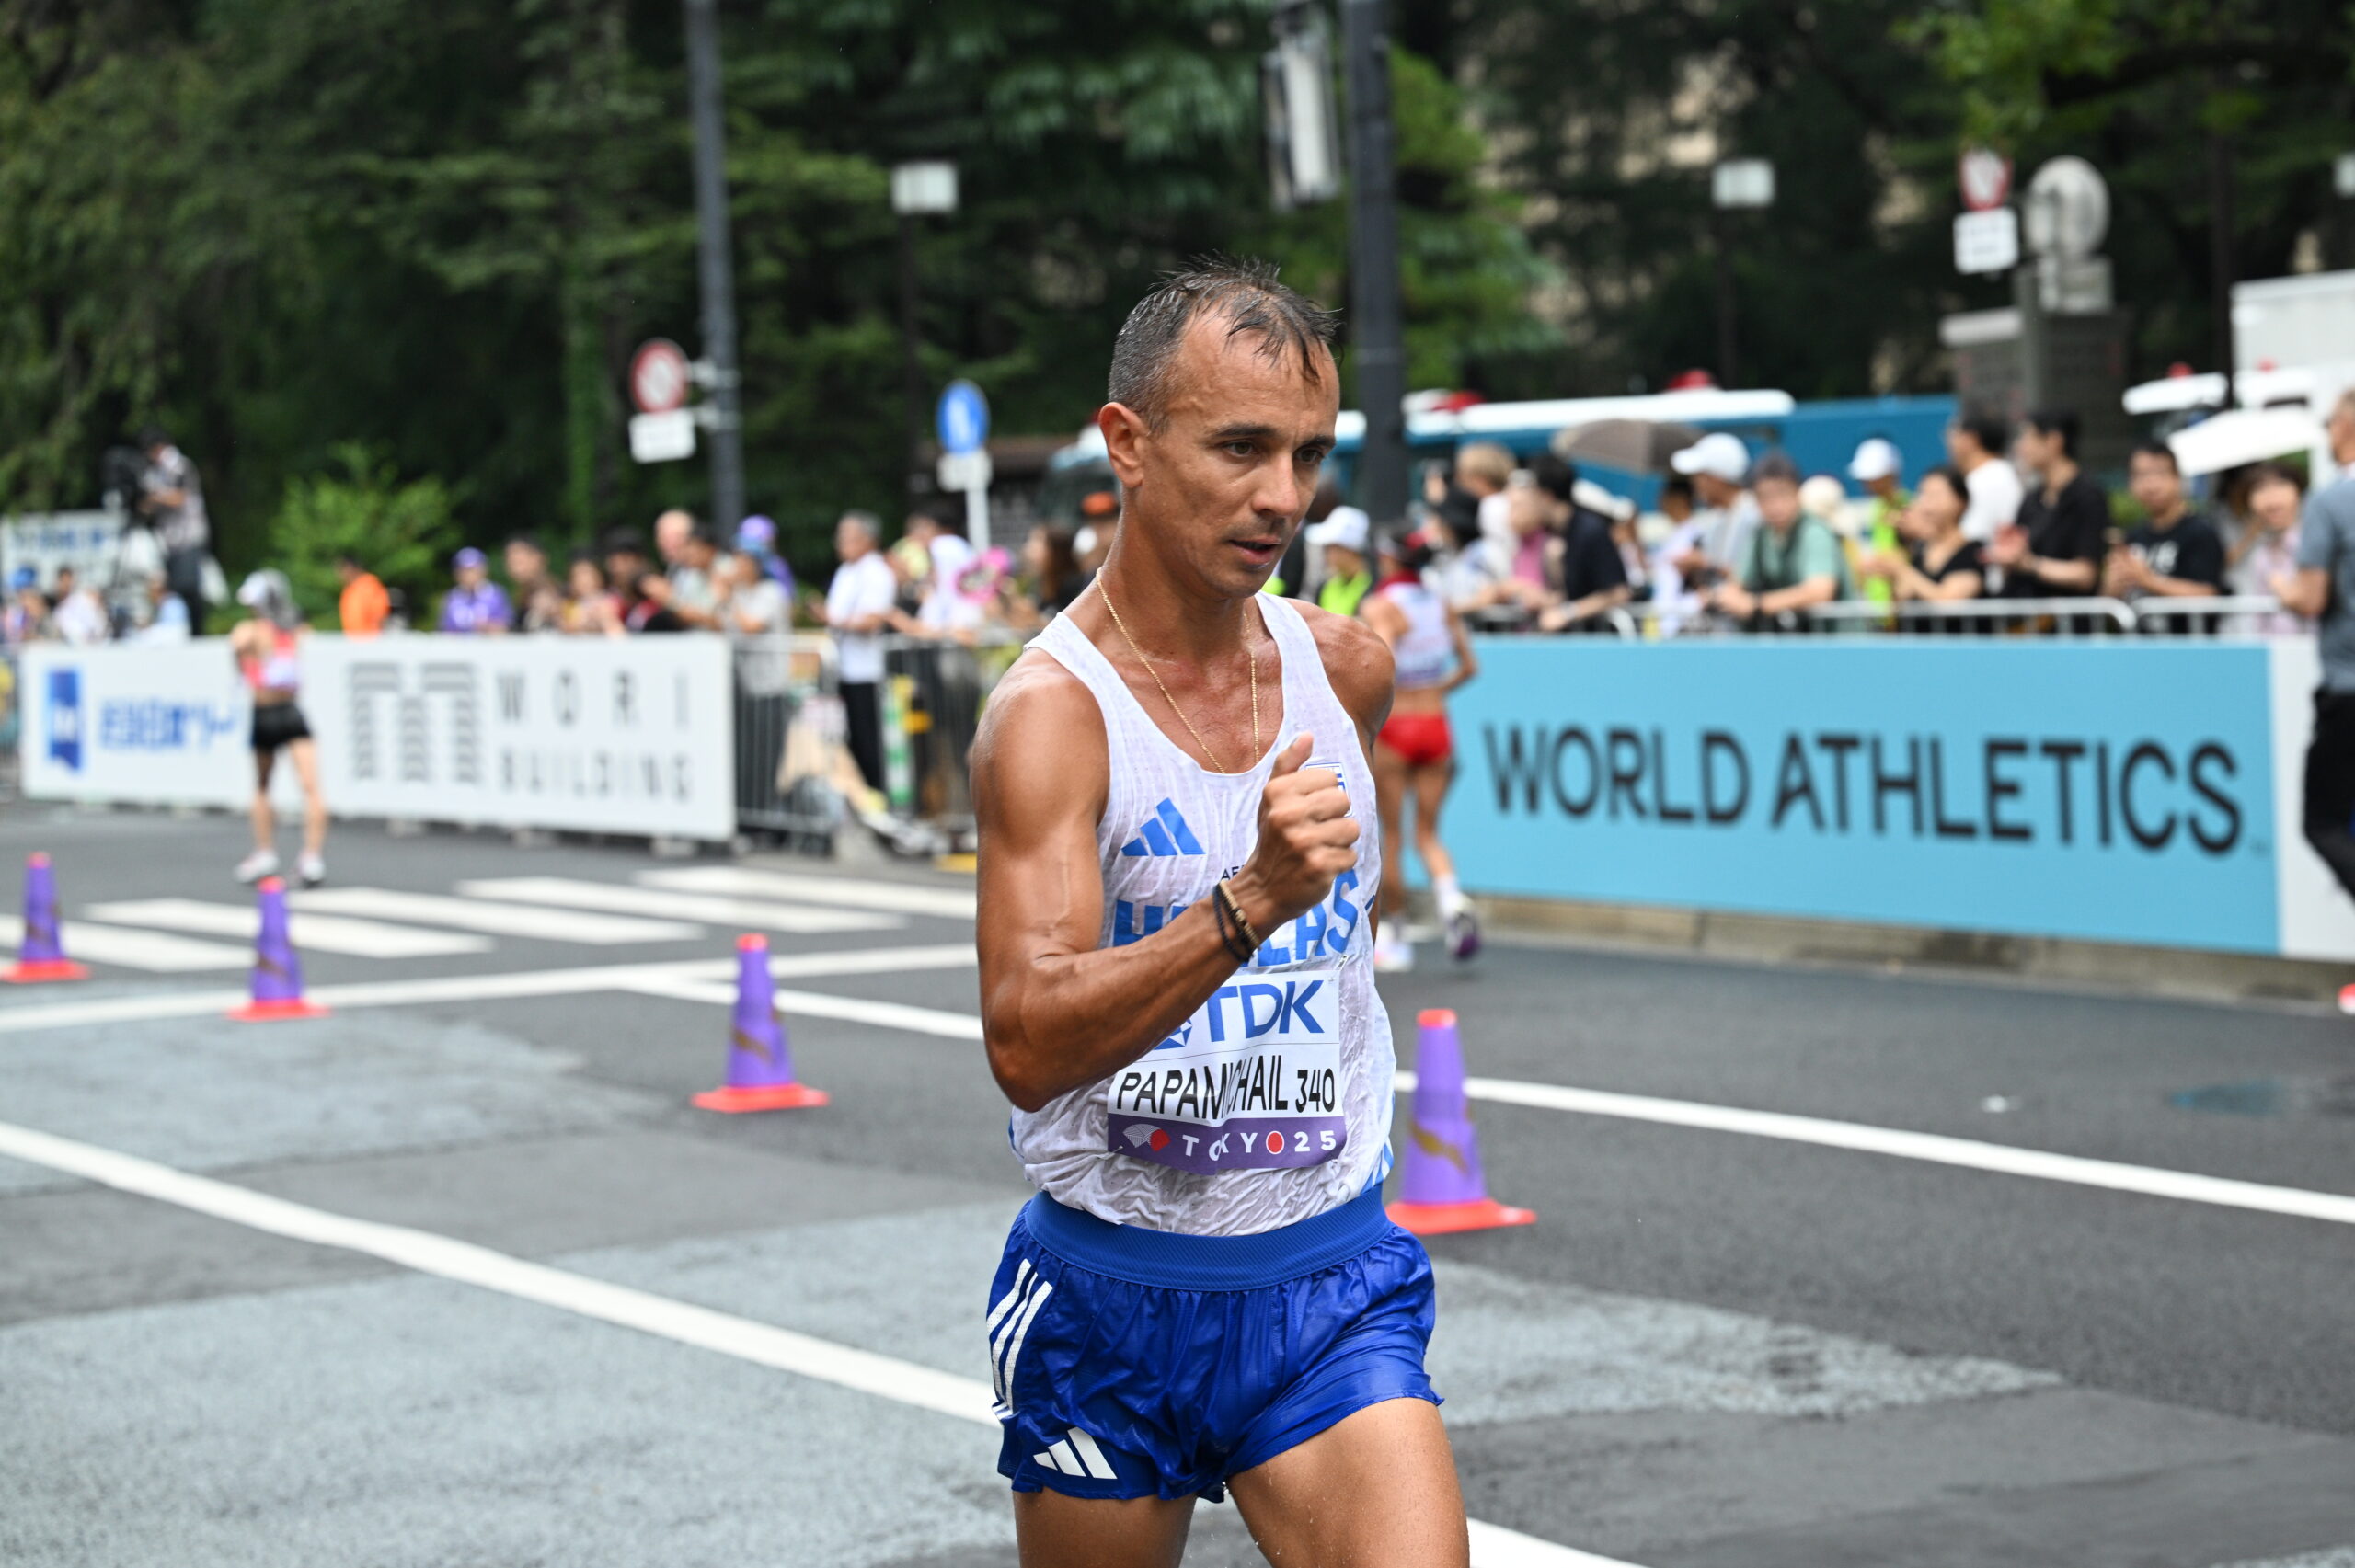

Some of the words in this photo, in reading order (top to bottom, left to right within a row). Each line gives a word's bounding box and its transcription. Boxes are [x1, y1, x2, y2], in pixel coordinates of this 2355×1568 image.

[1483, 724, 1751, 826] WORLD
[1770, 731, 2244, 854] ATHLETICS
[1207, 979, 1326, 1043] TDK
[1295, 1067, 1335, 1114] 340
